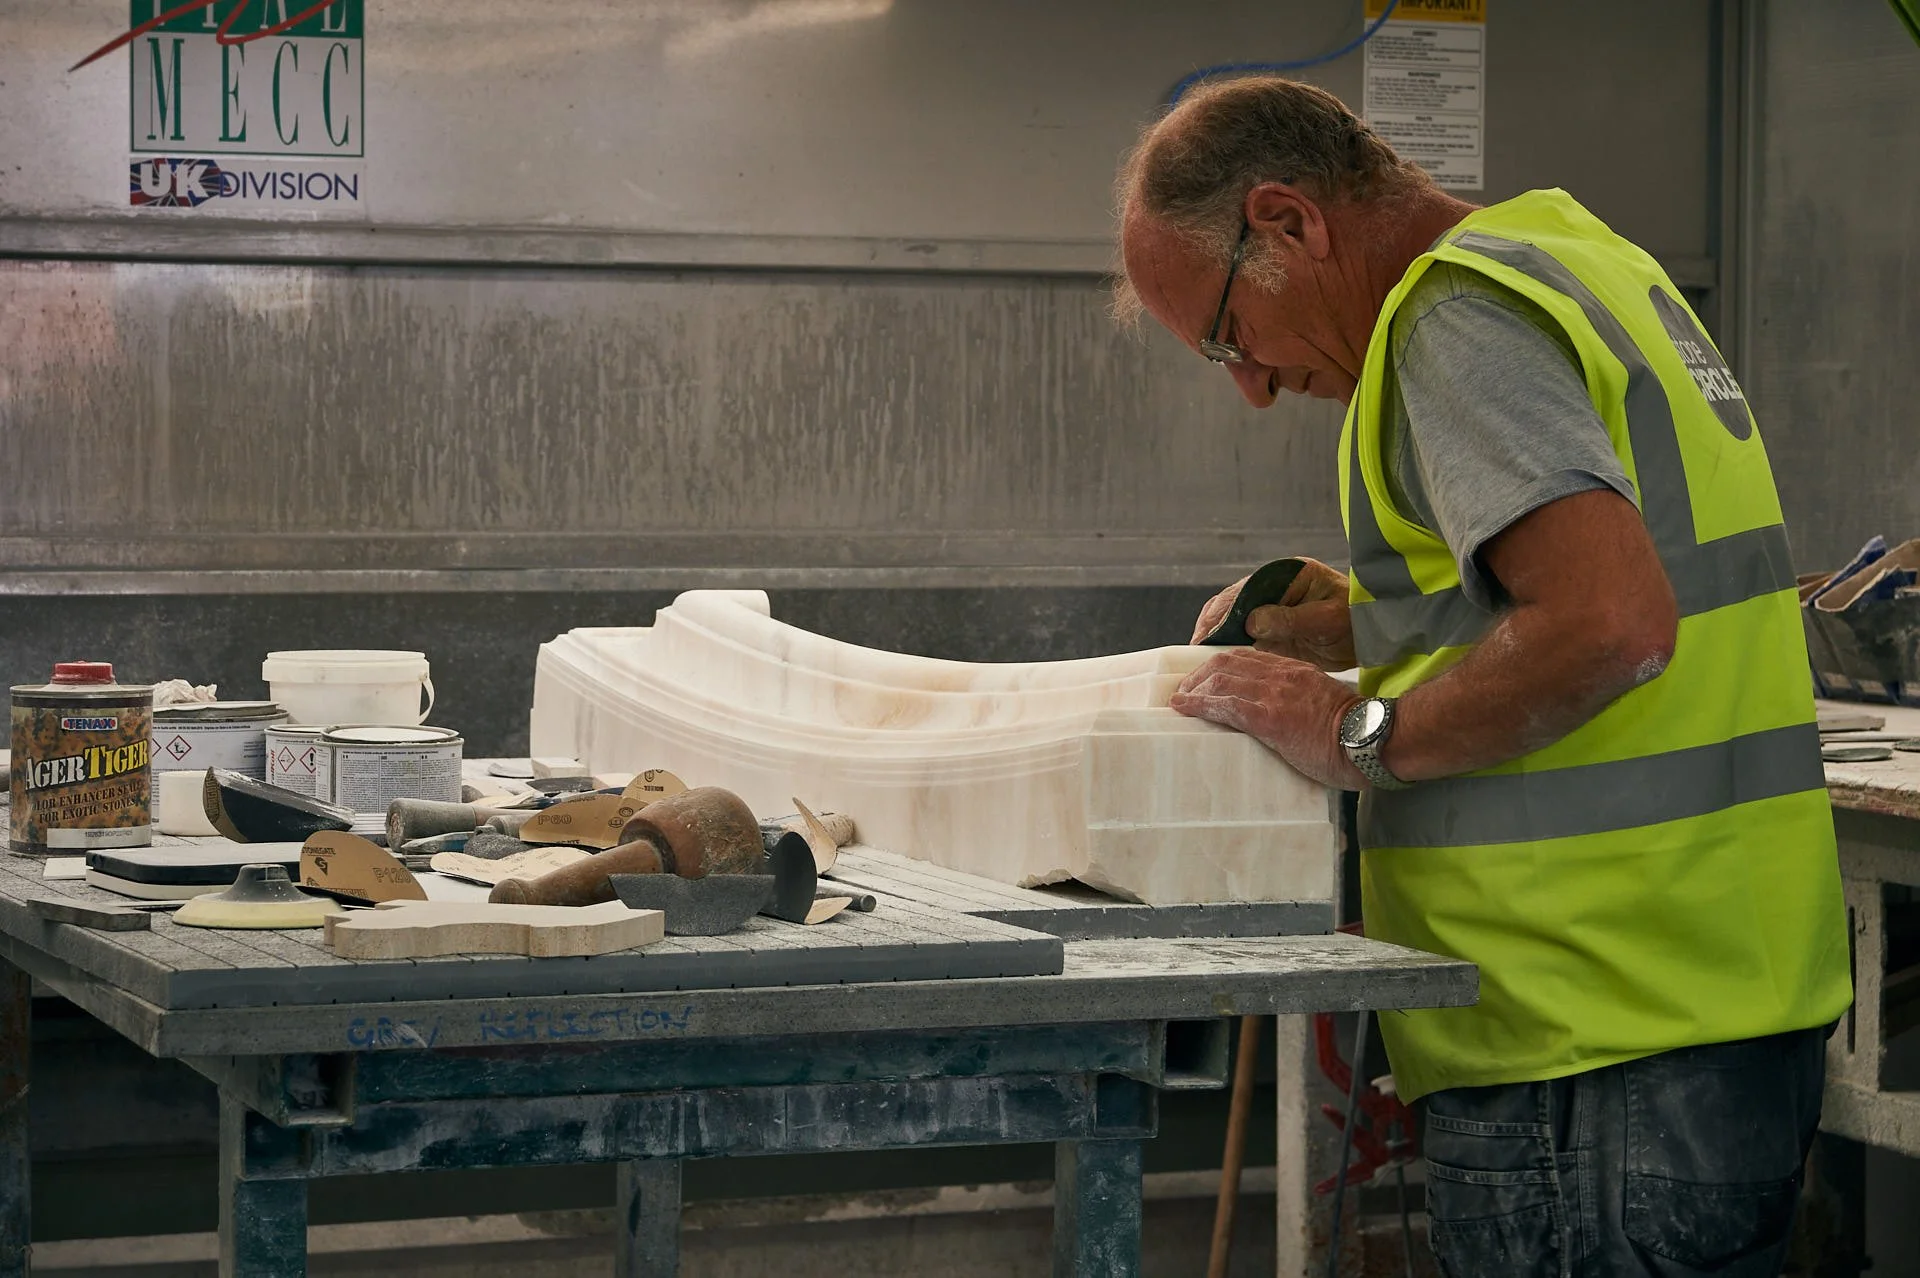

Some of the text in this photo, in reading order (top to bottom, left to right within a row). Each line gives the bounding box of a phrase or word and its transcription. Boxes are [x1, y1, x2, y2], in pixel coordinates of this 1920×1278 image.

[147, 37, 349, 147] MECC
[139, 163, 358, 200] UK DIVISION
[66, 718, 113, 730] TENAX
[60, 785, 115, 808] ENHANCER
[40, 811, 59, 823] FOR
[62, 803, 100, 820] EXOTIC
[538, 814, 572, 825] P60
[479, 1005, 694, 1042] REFLECTION
